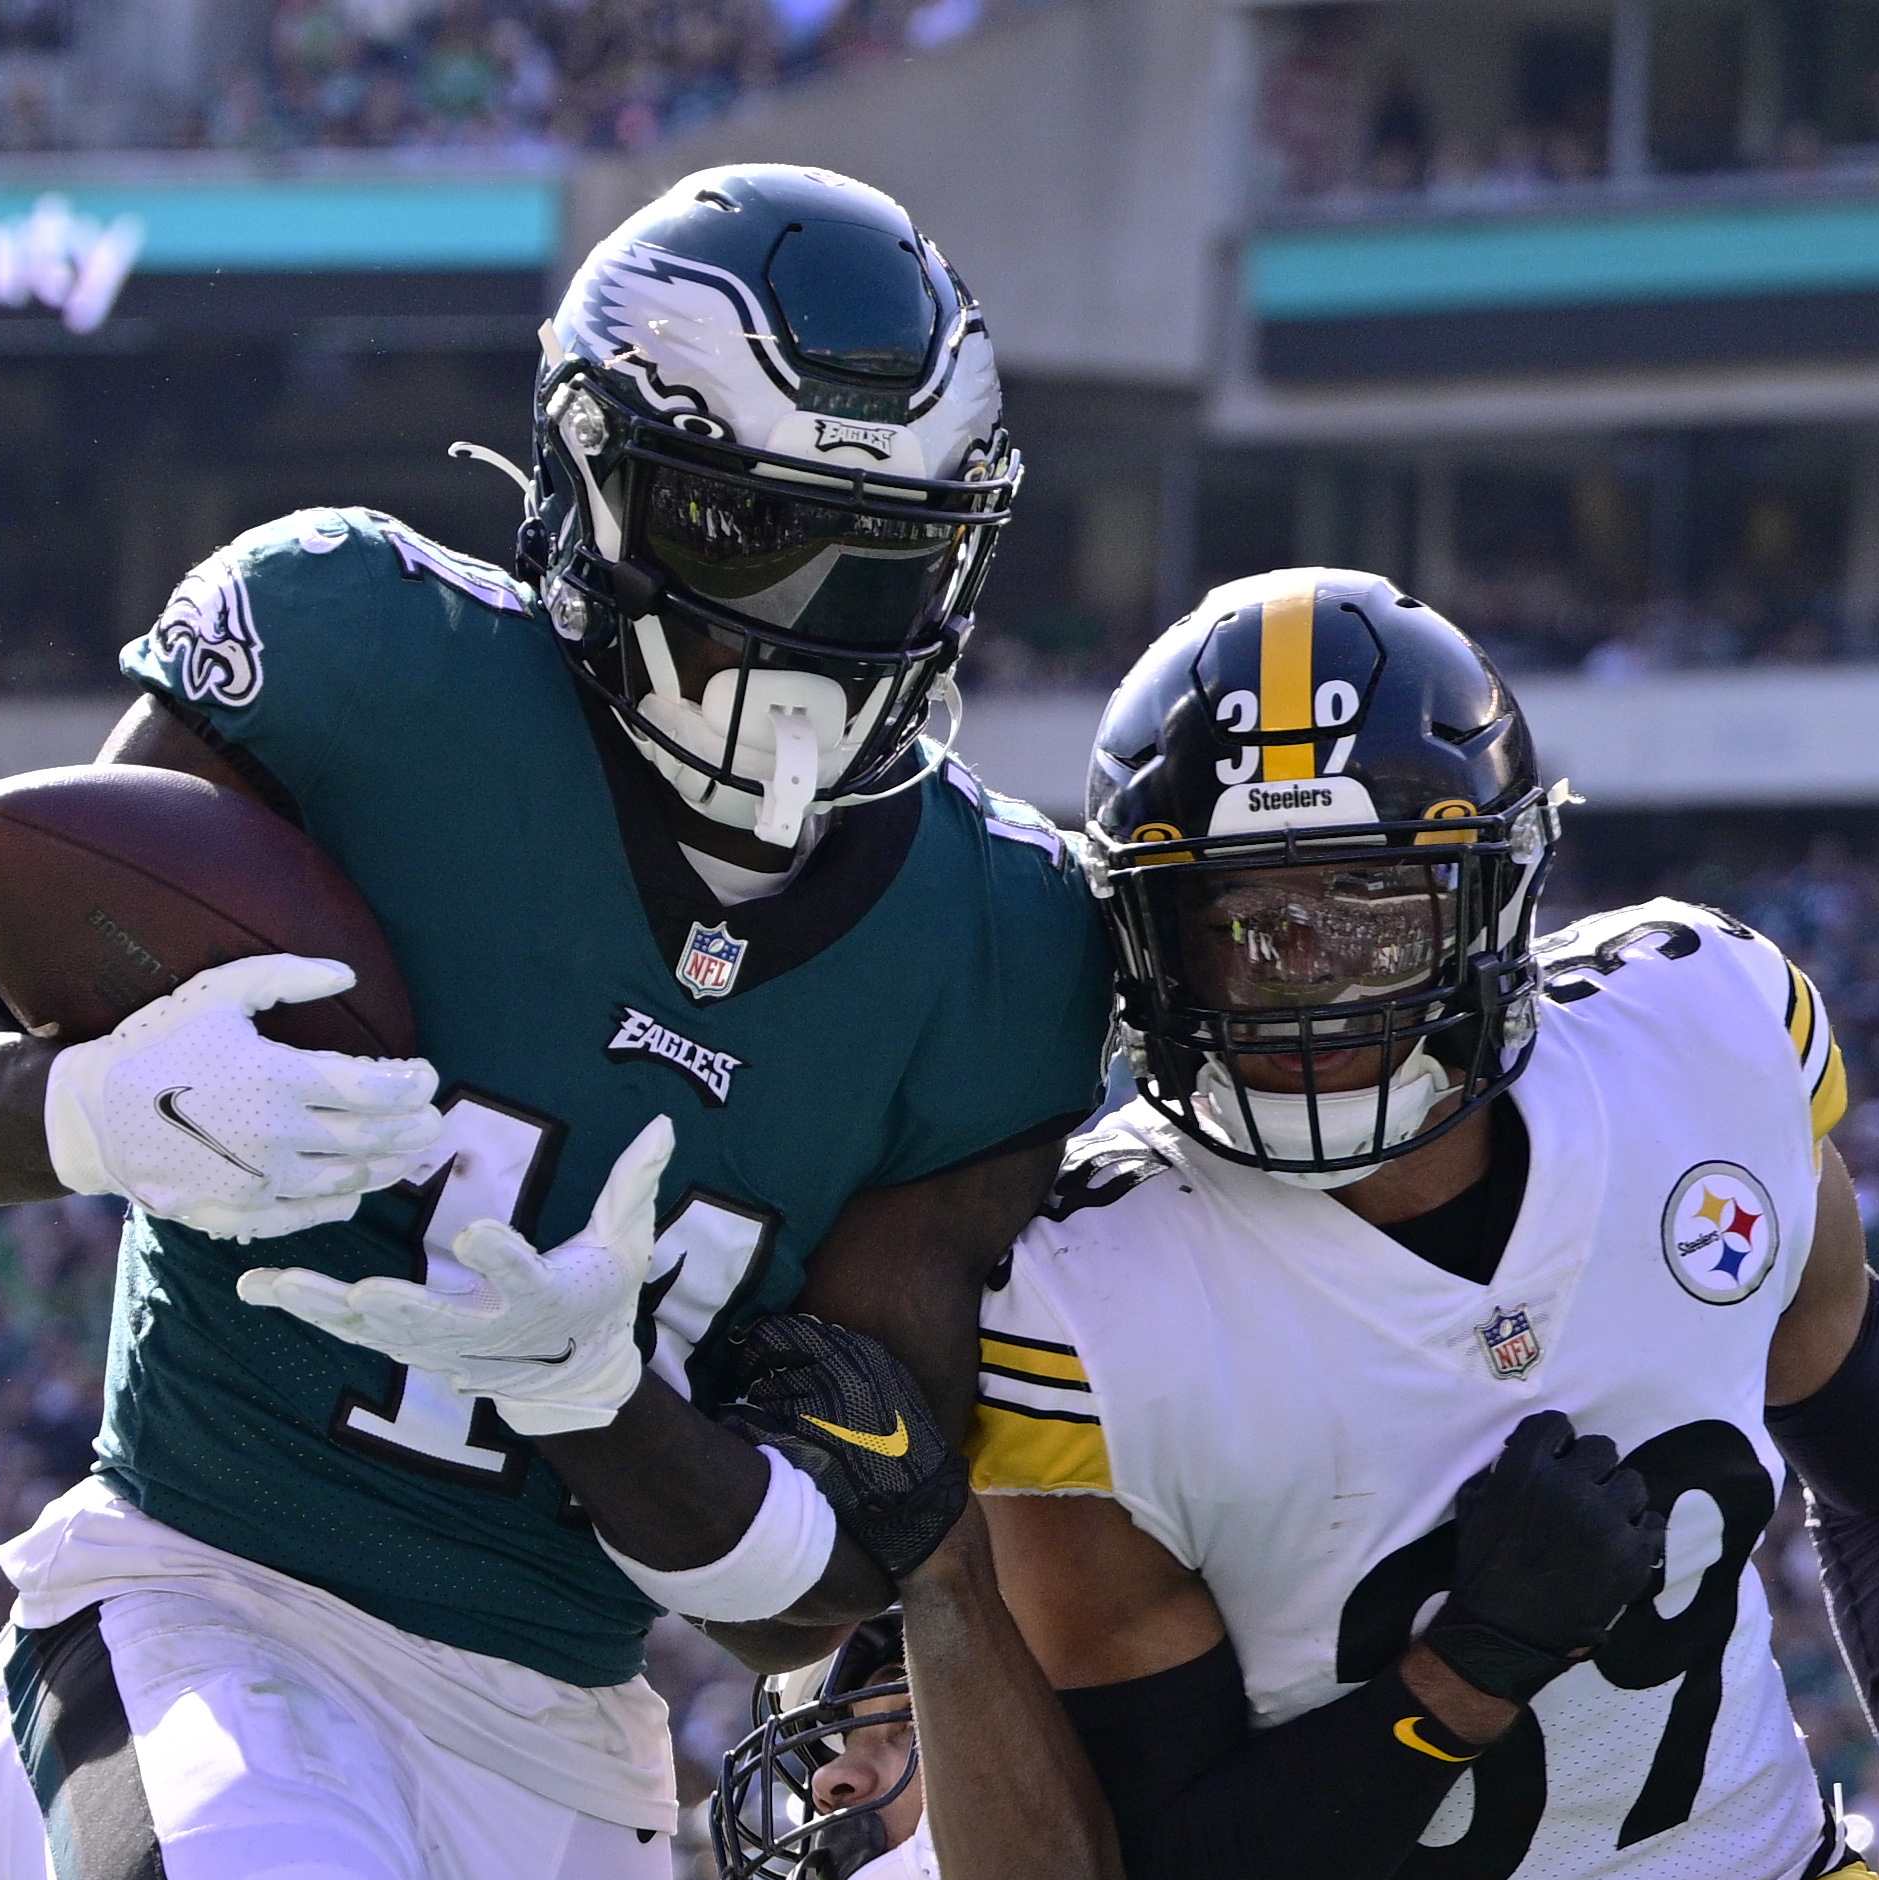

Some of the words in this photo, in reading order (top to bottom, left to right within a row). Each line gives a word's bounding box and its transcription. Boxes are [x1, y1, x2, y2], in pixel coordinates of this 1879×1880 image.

[815, 419, 897, 459] EAGLES
[1247, 783, 1334, 813] Steelers
[685, 951, 728, 988] NFL
[607, 1006, 743, 1104] EAGLES
[1494, 1333, 1537, 1371] NFL
